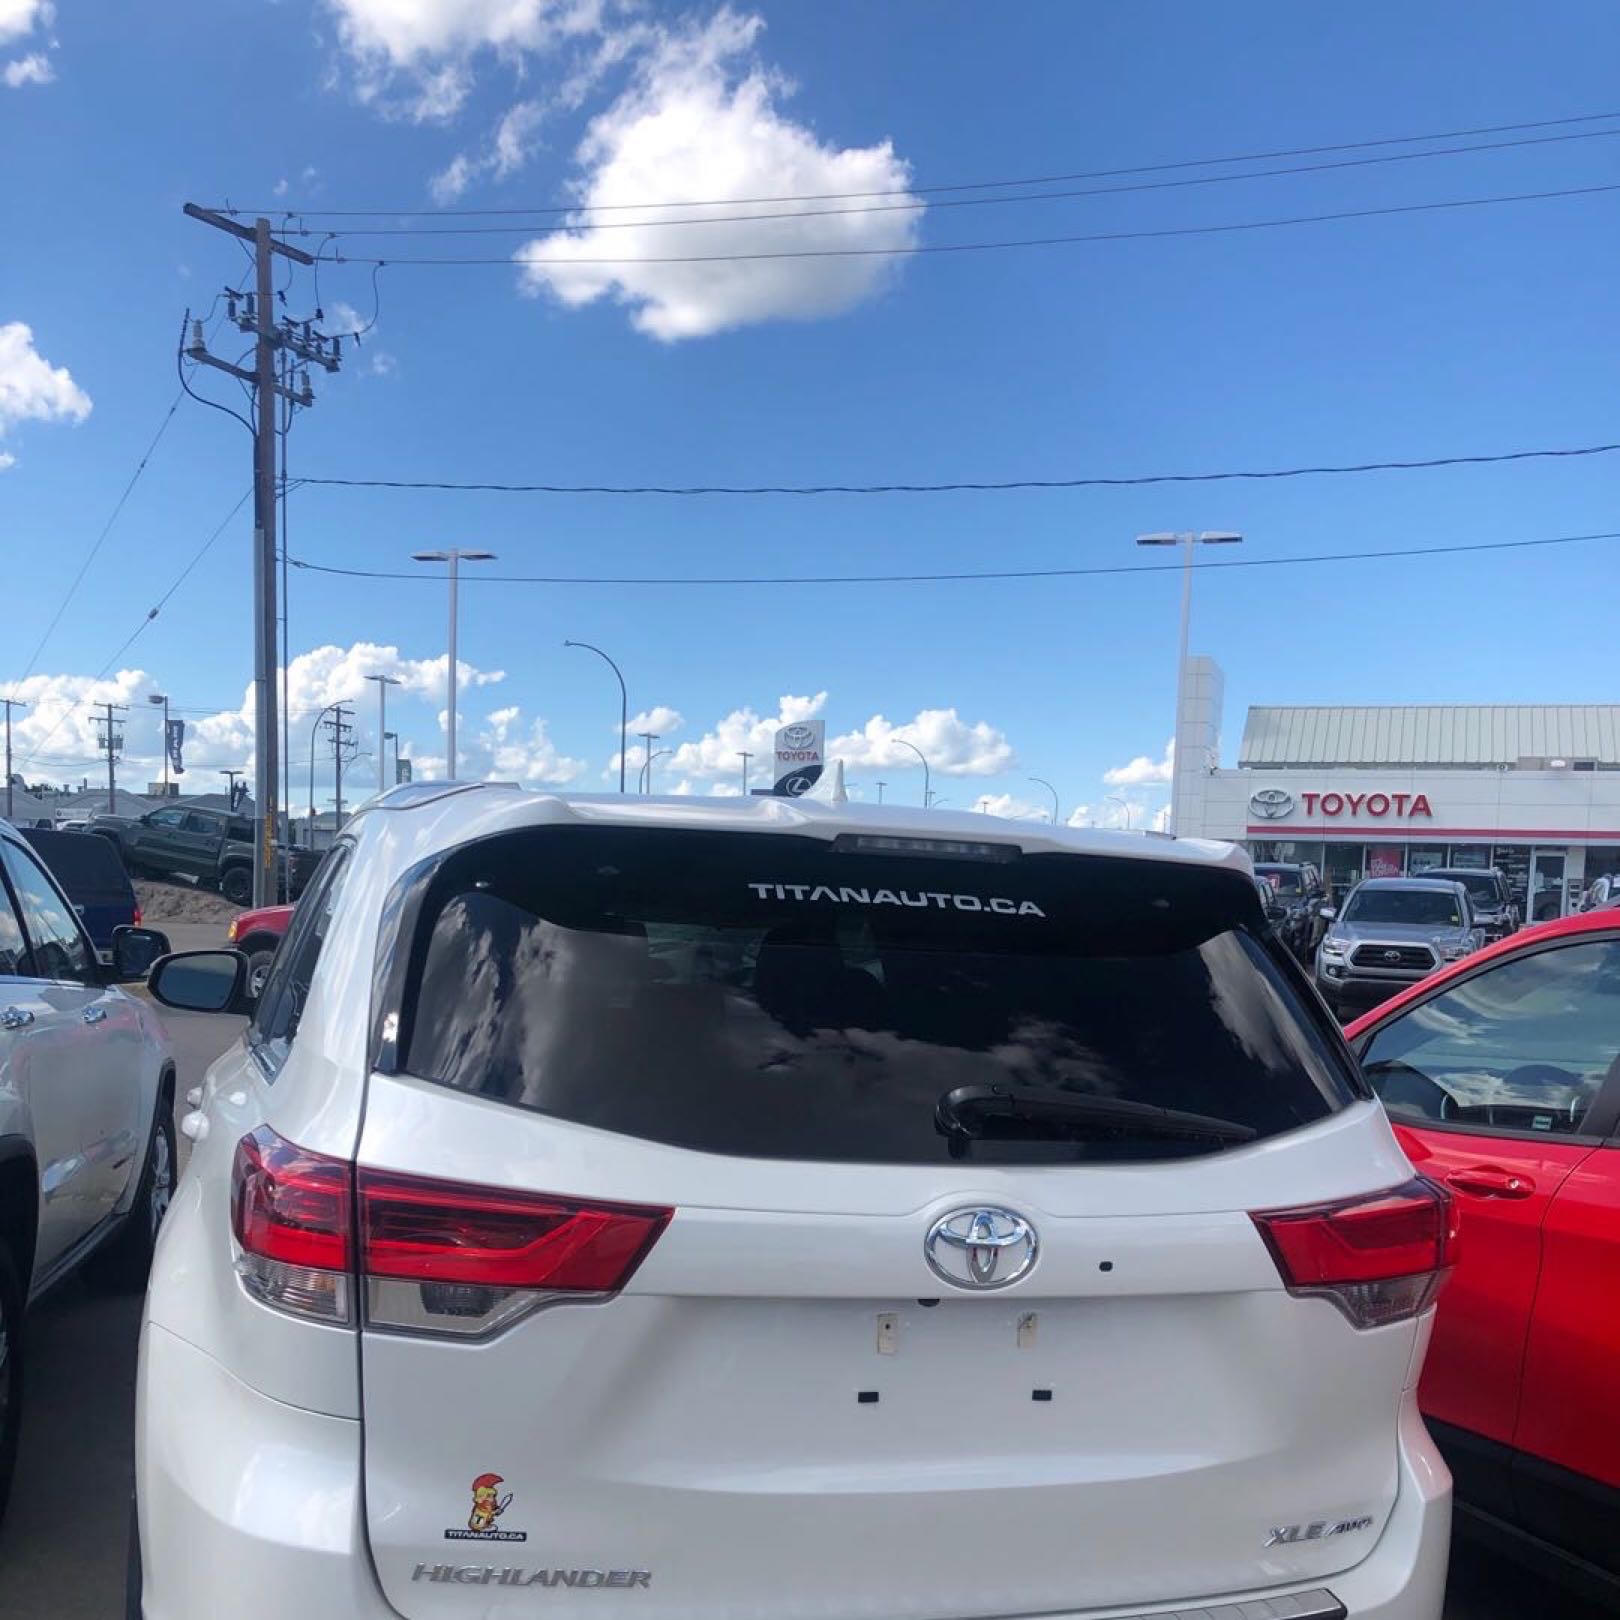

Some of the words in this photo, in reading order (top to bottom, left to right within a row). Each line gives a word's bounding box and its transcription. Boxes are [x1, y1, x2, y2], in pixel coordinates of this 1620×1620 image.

[775, 751, 819, 761] TOYOTA
[1302, 793, 1432, 817] TOYOTA
[748, 883, 1046, 918] TITANAUTO.CA
[448, 1530, 524, 1540] TITANAUTO.CA
[1263, 1520, 1326, 1548] XLE
[411, 1562, 653, 1589] HIGHLANDER
